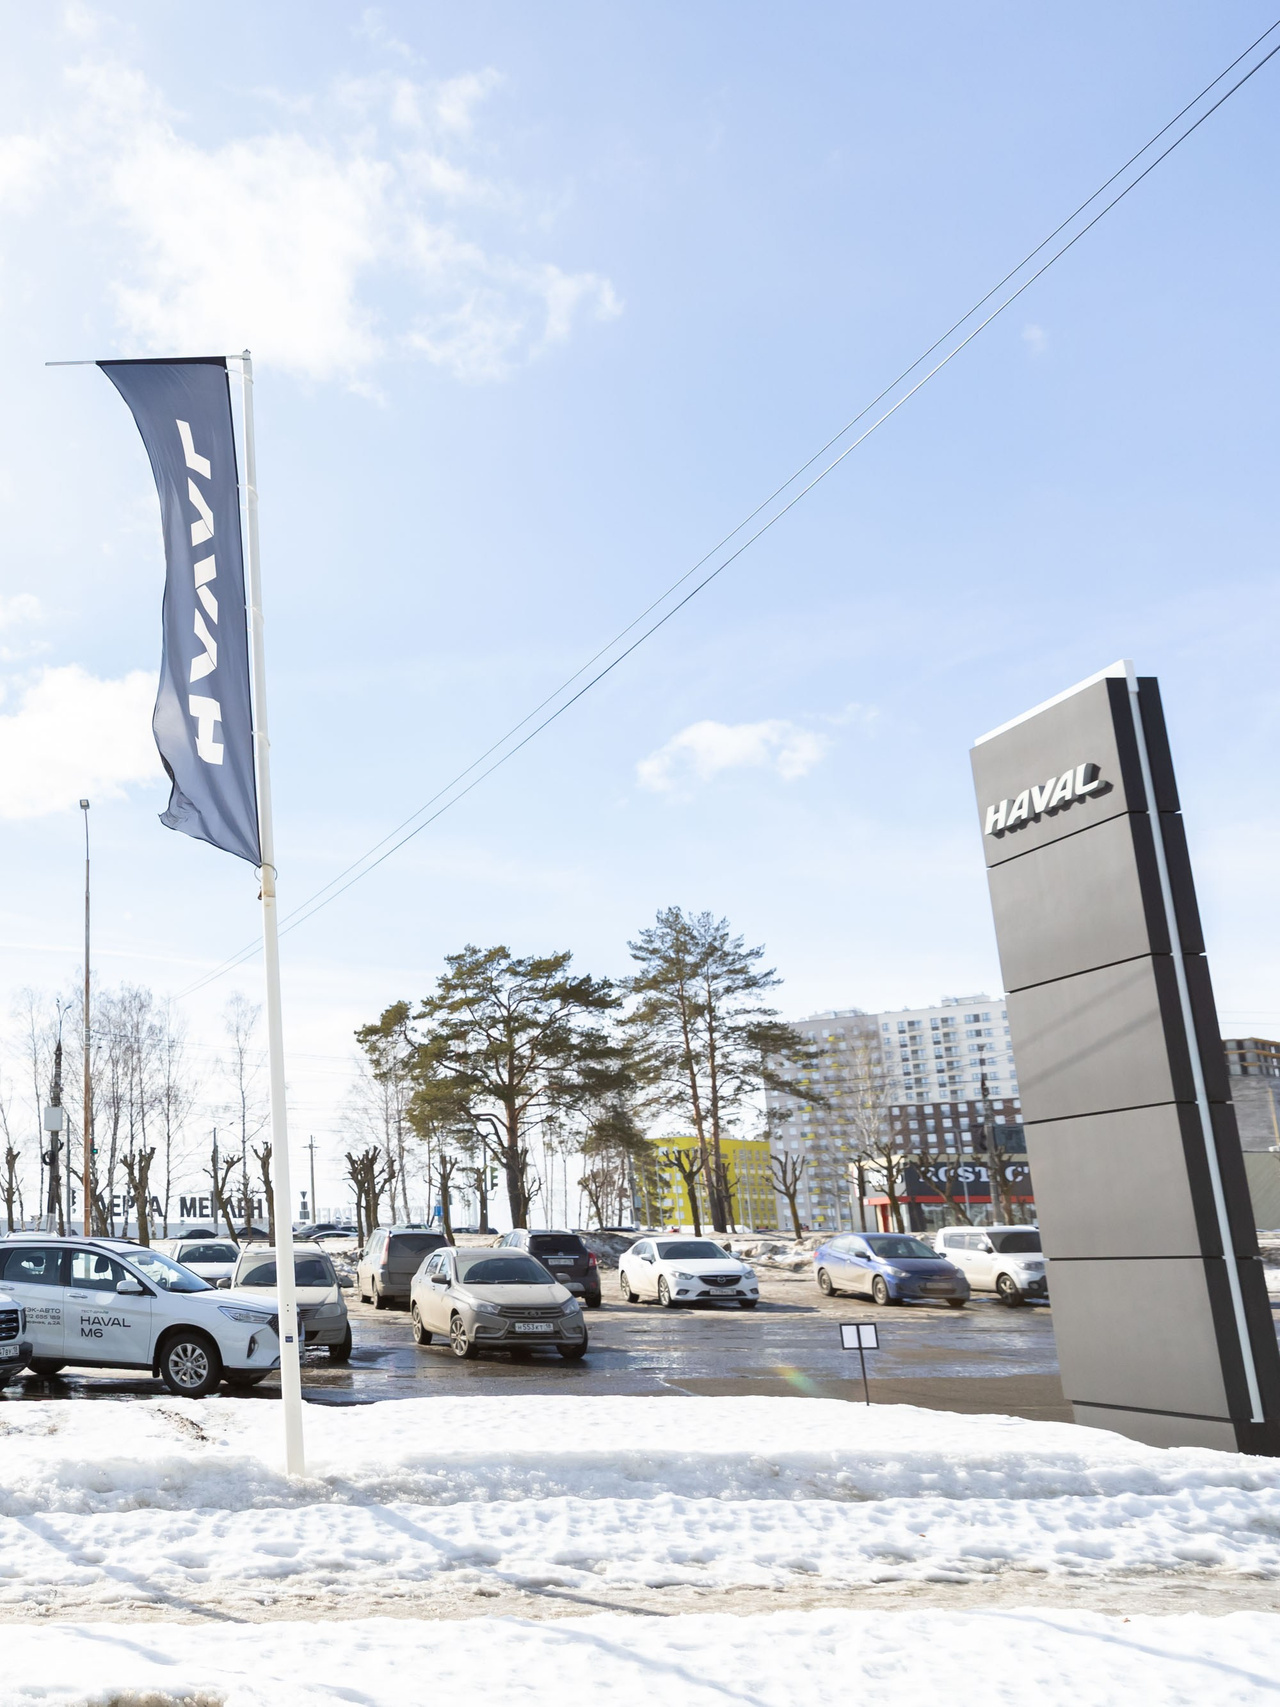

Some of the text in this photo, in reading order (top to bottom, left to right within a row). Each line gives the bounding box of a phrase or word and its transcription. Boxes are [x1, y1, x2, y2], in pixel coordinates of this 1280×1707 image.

[985, 763, 1104, 835] HAVAL
[80, 1316, 131, 1328] HAVAL
[80, 1327, 104, 1338] M6
